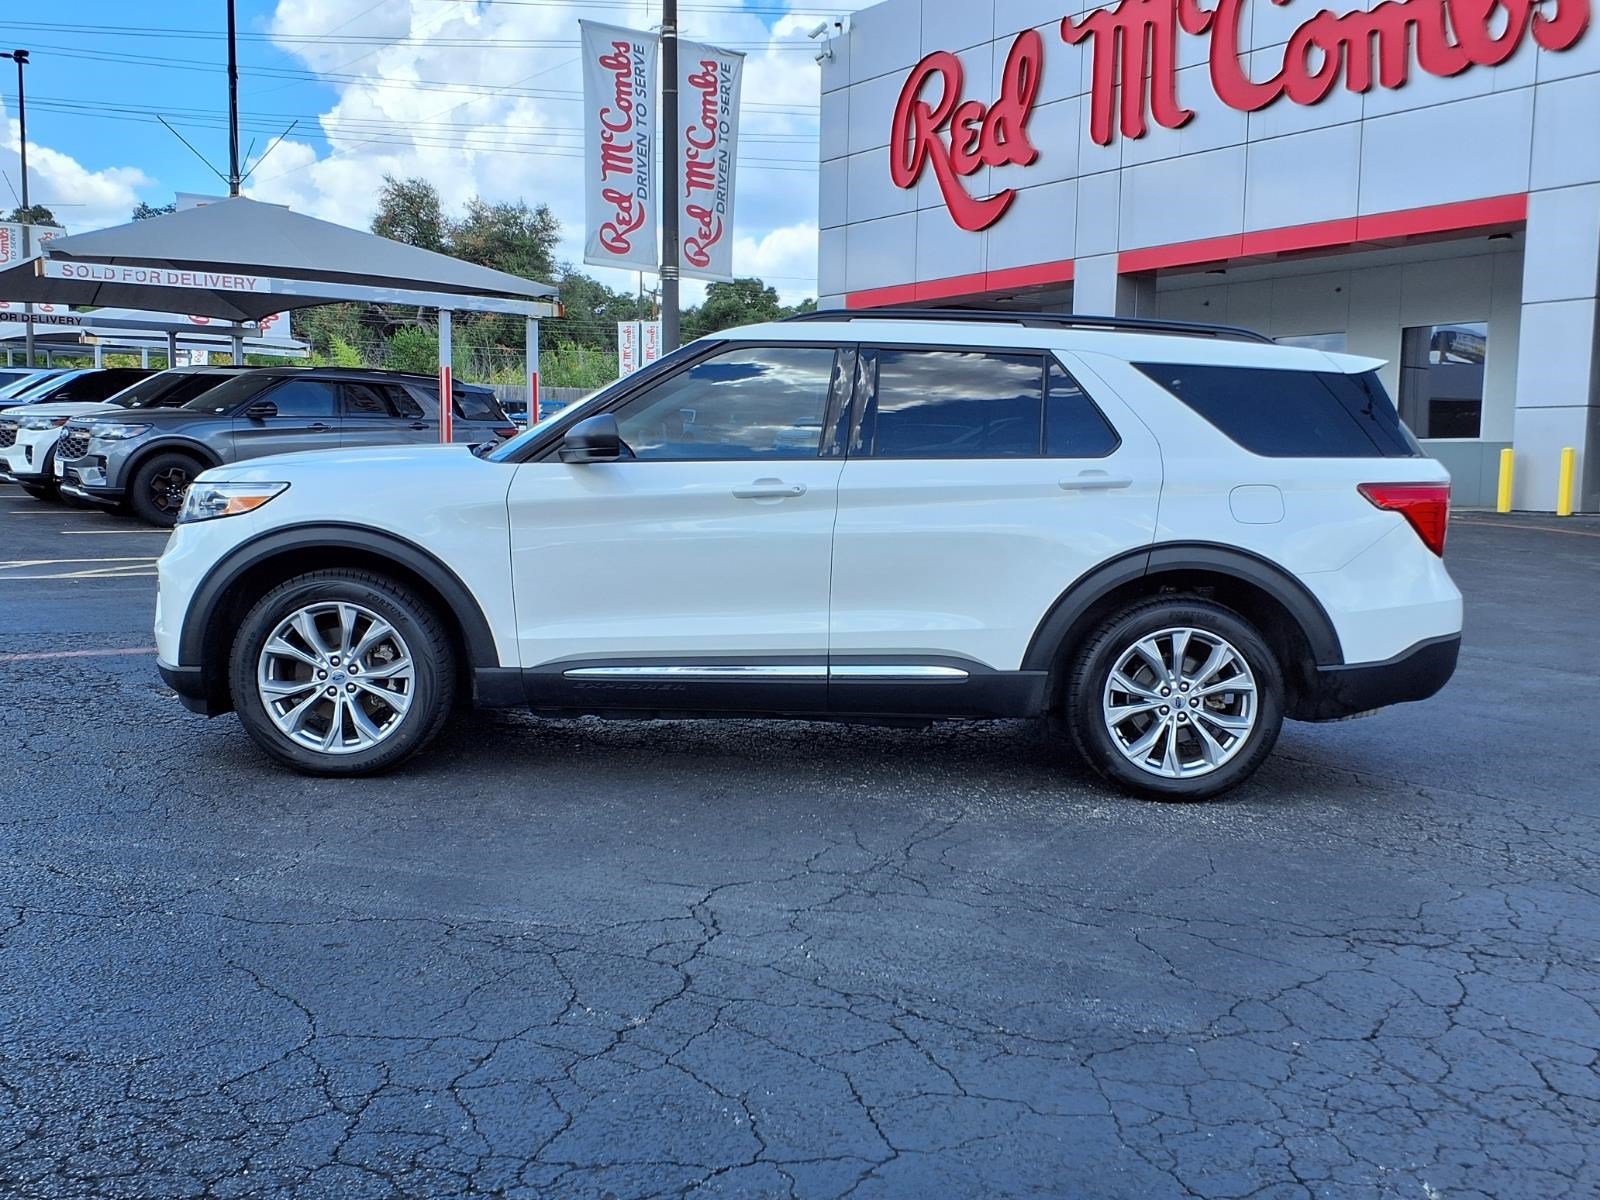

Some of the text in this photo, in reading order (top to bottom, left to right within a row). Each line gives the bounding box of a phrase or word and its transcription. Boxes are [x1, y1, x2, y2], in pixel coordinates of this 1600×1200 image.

[599, 41, 645, 255] Red McCombs
[633, 43, 647, 200] DRIVEN TO SERVE
[683, 61, 723, 268] Red McCombs
[716, 62, 731, 215] DRIVEN TO SERVE
[890, 29, 1043, 232] Red
[0, 312, 82, 326] OR DELIVERY
[10, 250, 16, 260] TO
[62, 263, 257, 291] SOLD FOR DELIVERY
